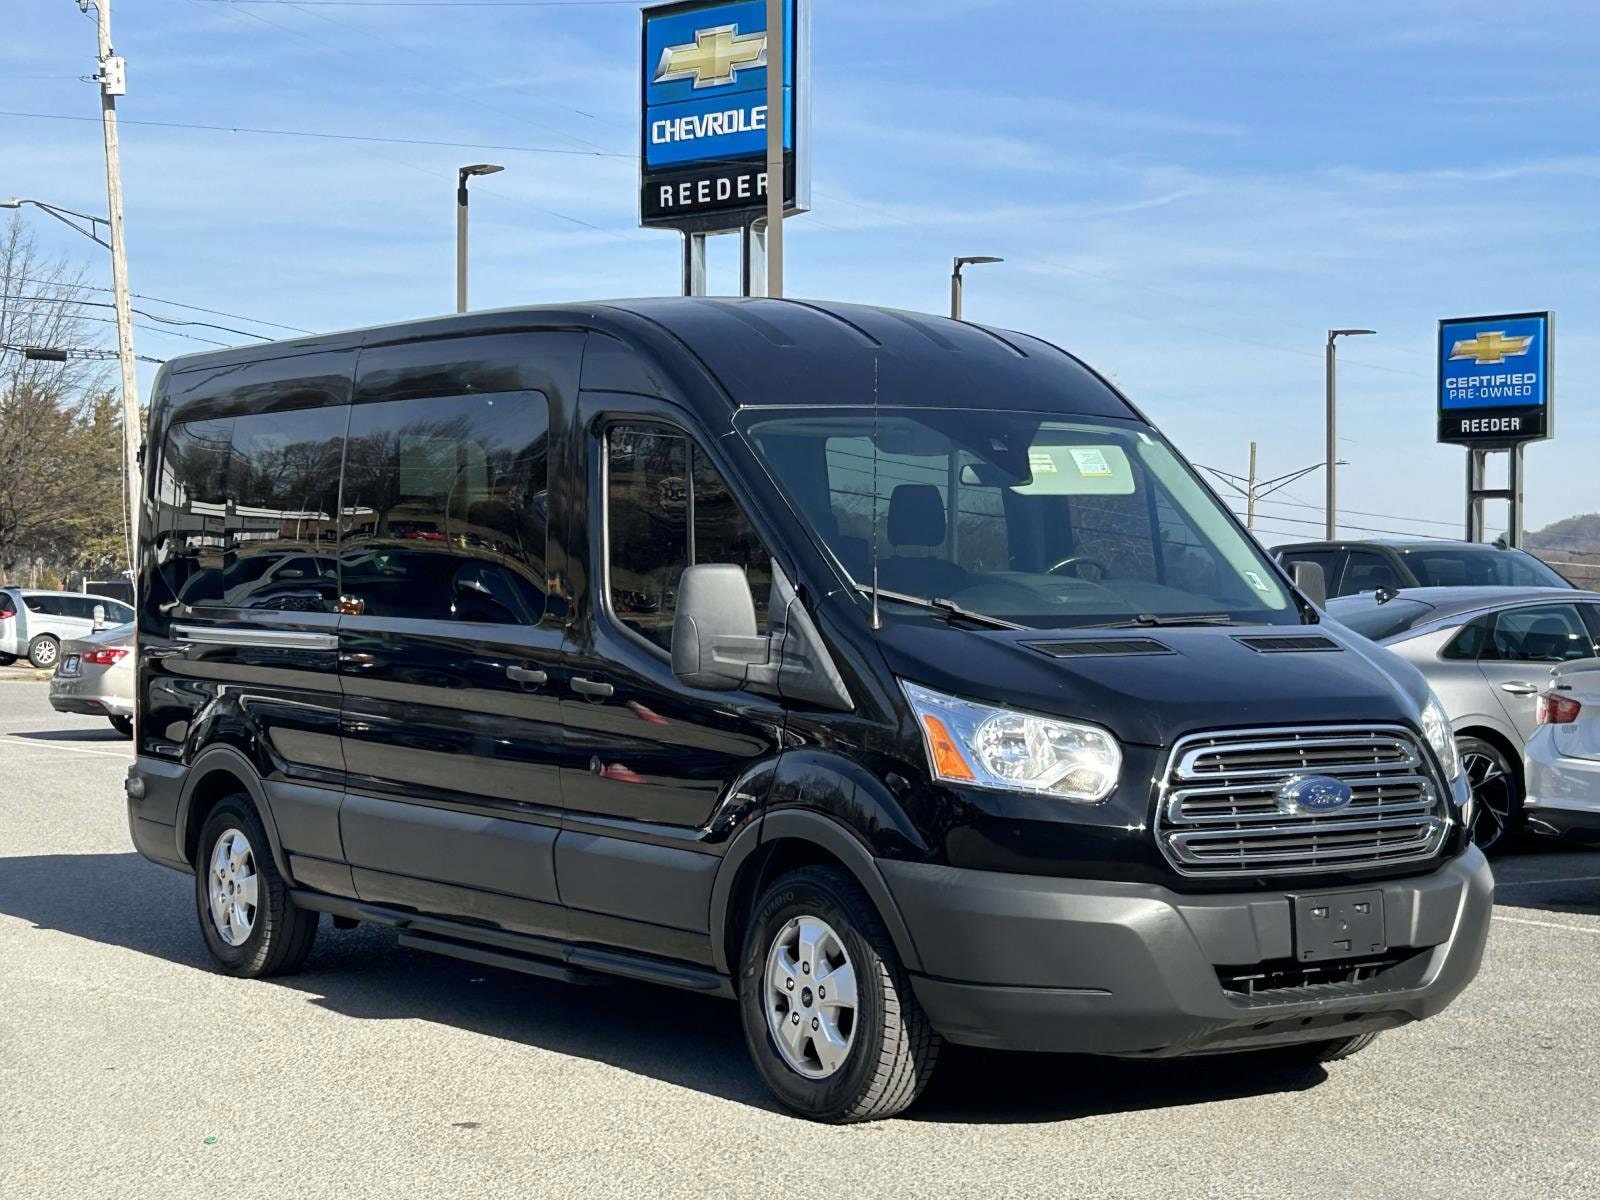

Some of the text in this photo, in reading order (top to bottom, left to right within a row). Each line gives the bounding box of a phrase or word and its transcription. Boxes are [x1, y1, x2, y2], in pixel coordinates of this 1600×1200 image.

[652, 105, 767, 143] CHEVROLE
[660, 173, 768, 207] REEDER
[1445, 373, 1536, 388] CERTIFIED
[1449, 385, 1532, 400] PRE-OWNED
[1461, 417, 1520, 433] REEDER
